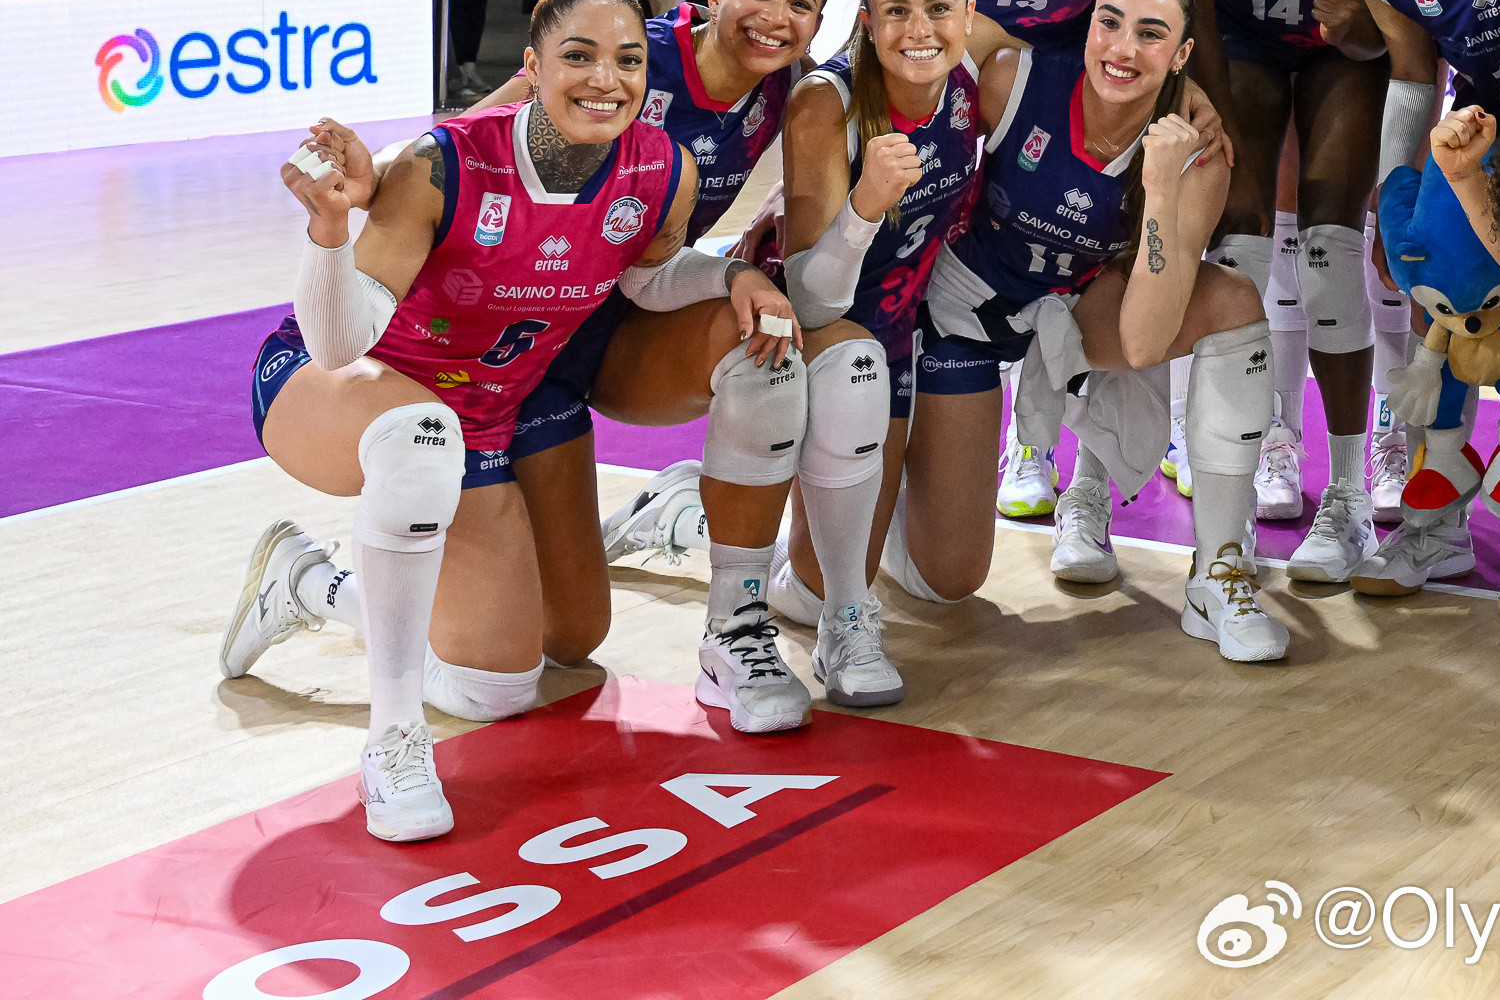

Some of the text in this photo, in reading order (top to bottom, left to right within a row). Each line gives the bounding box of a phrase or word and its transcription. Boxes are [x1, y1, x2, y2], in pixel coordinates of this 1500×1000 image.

[170, 11, 378, 99] estra
[466, 156, 515, 174] mediolanum
[898, 183, 937, 206] AVINO
[940, 173, 962, 189] DEL
[1056, 204, 1088, 225] errea
[896, 214, 935, 259] 3
[1018, 211, 1071, 239] SAVINO
[1075, 235, 1103, 250] DEL
[535, 259, 569, 271] errea
[1025, 242, 1075, 277] 11
[1309, 260, 1329, 268] errea
[494, 285, 555, 299] SAVINO
[559, 284, 589, 299] DEL
[487, 303, 512, 312] Global
[513, 304, 545, 312] Logistics
[478, 319, 551, 368] 5
[1246, 364, 1267, 375] errea
[770, 371, 796, 386] errea
[851, 372, 877, 384] errea
[414, 435, 446, 446] errea
[480, 455, 509, 470] errea
[327, 570, 353, 608] rrea
